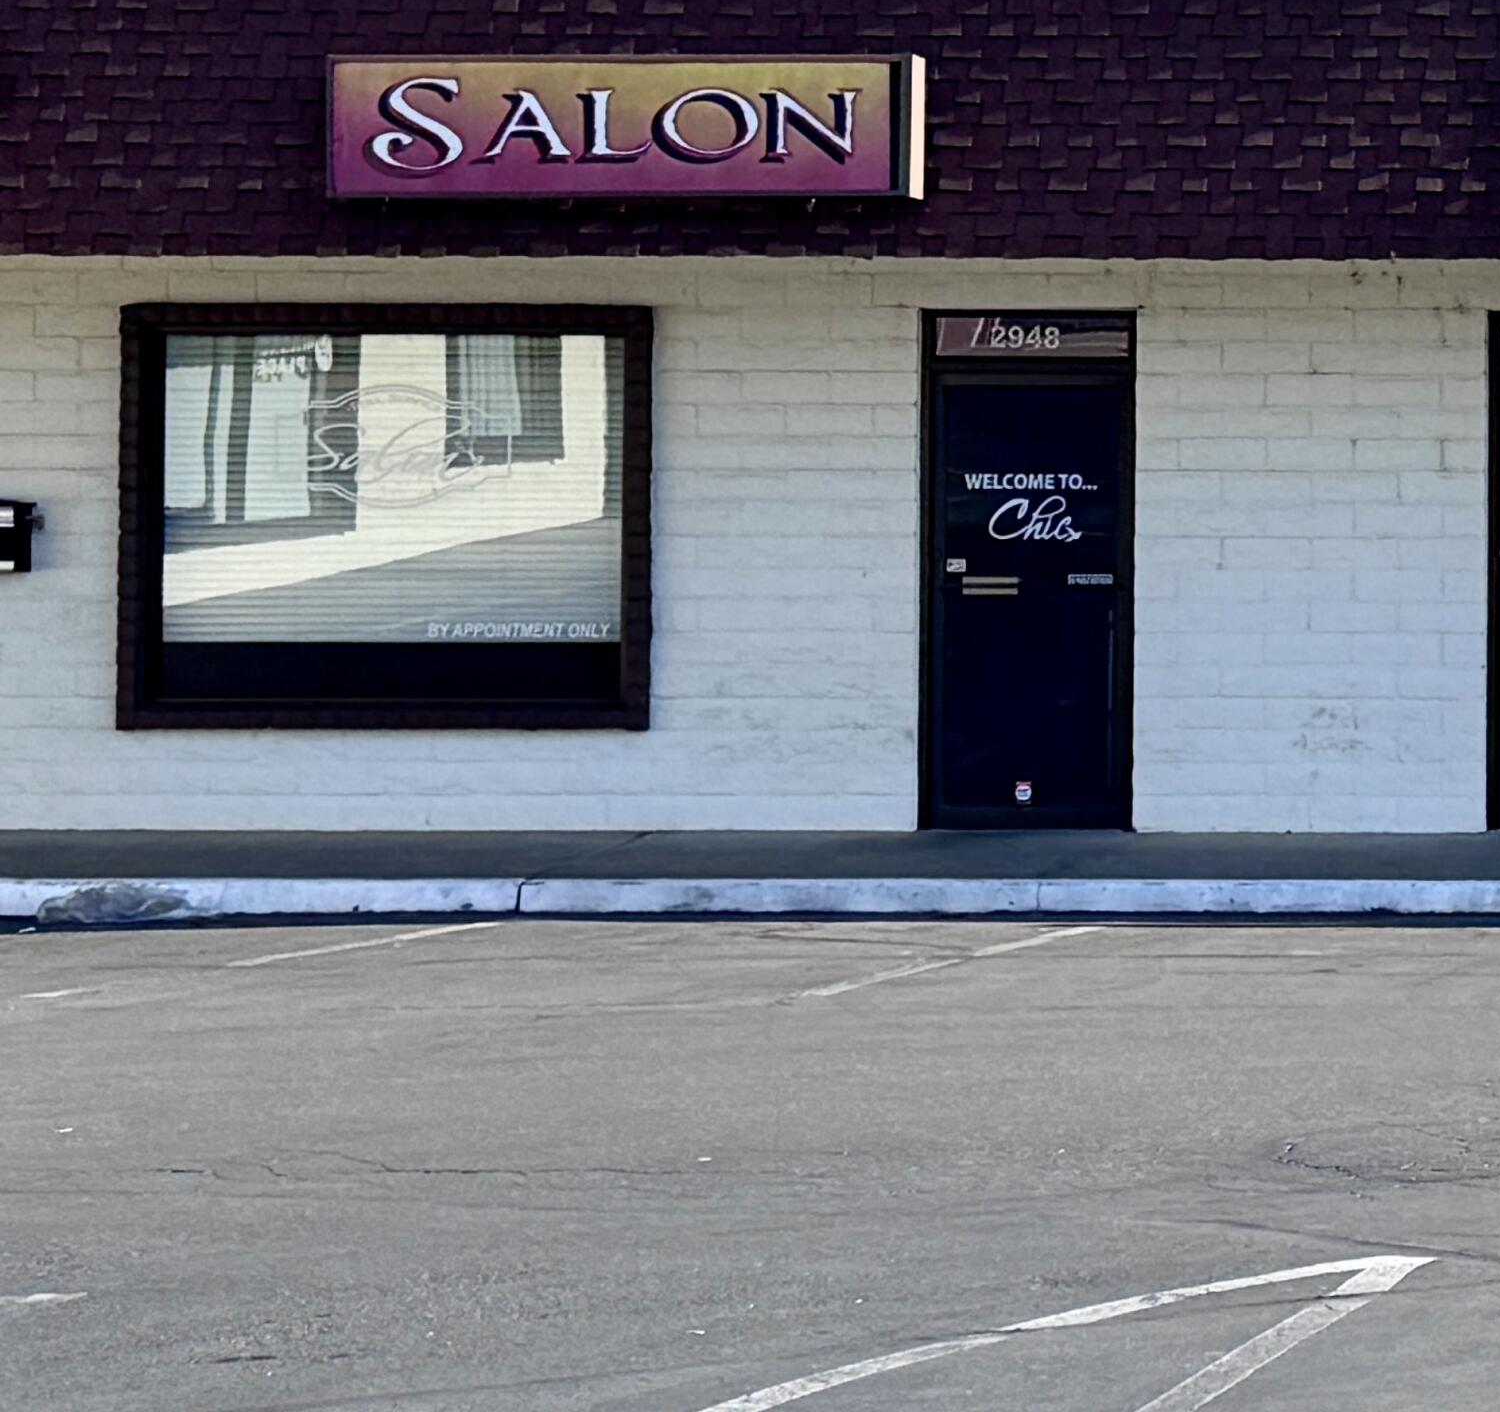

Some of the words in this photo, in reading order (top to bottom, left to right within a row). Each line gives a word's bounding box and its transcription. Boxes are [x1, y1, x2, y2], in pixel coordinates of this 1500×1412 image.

[368, 77, 858, 177] SALON
[991, 325, 1060, 349] 2948
[964, 473, 1055, 490] WELCOME
[427, 622, 450, 638] BY
[451, 622, 565, 638] APPOINTMENT
[567, 622, 610, 638] ONLY
